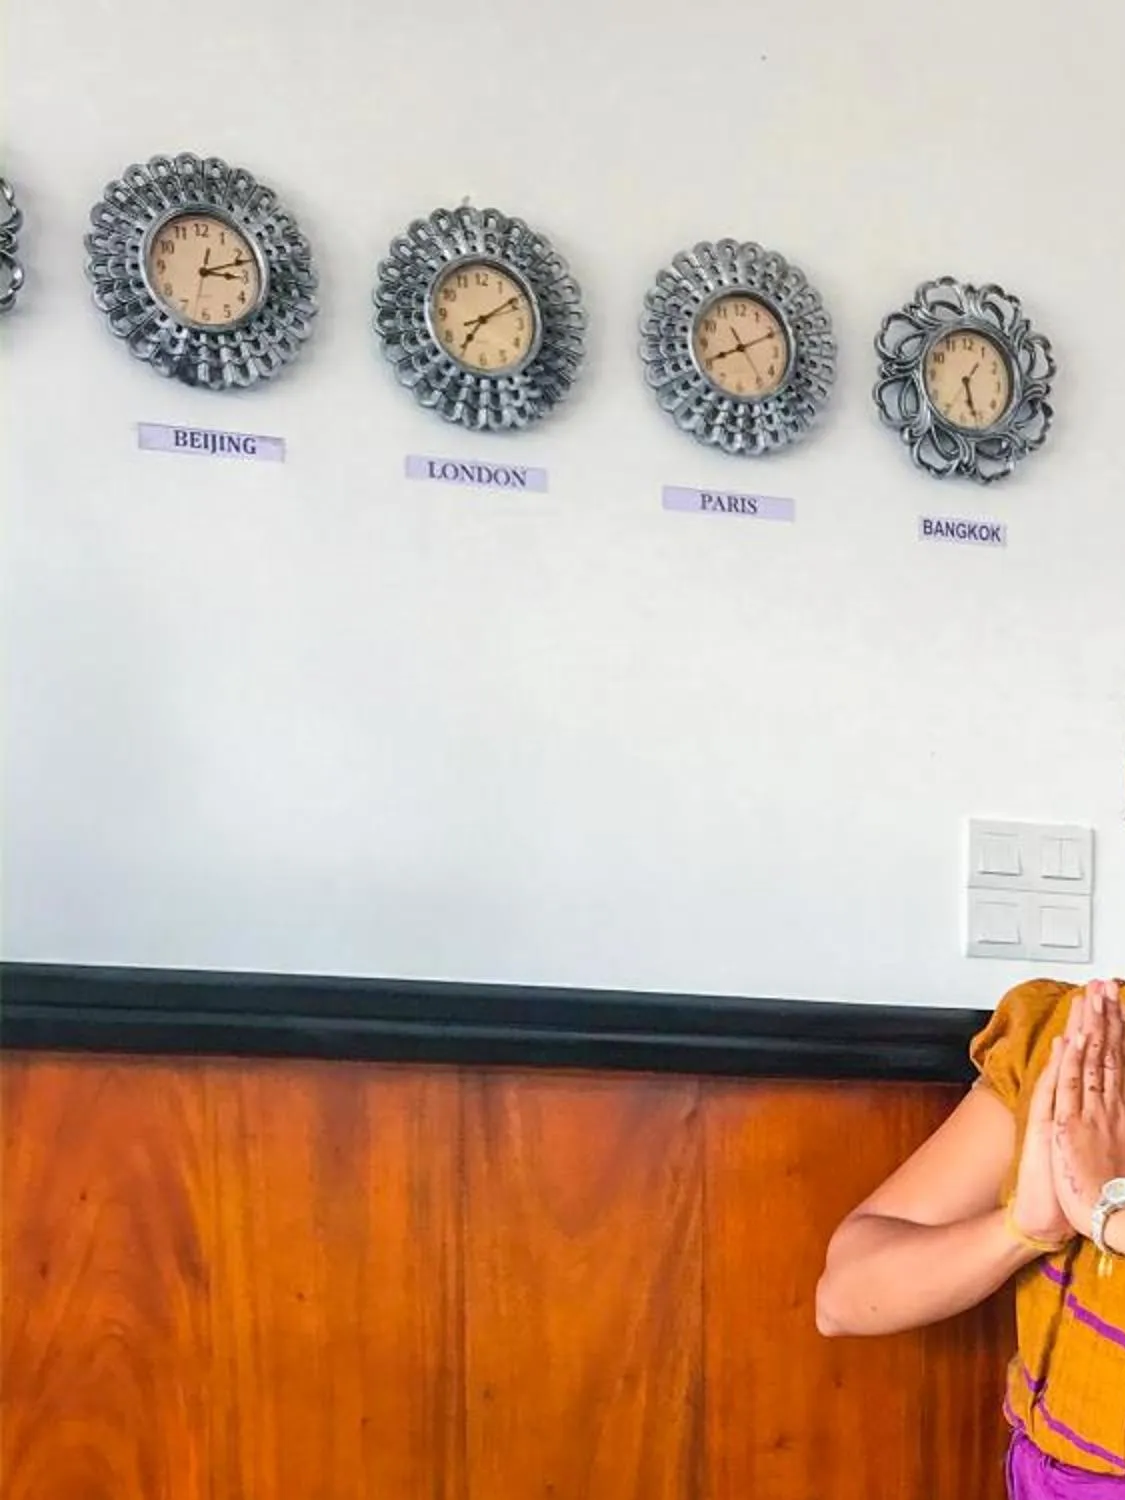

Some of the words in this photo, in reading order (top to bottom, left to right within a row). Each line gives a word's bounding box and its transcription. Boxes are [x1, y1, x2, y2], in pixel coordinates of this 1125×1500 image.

[194, 223, 209, 238] 12
[173, 429, 257, 455] BEIJING
[427, 460, 527, 488] LONDON
[700, 493, 758, 514] PARIS
[922, 519, 1001, 542] BANGKOK
